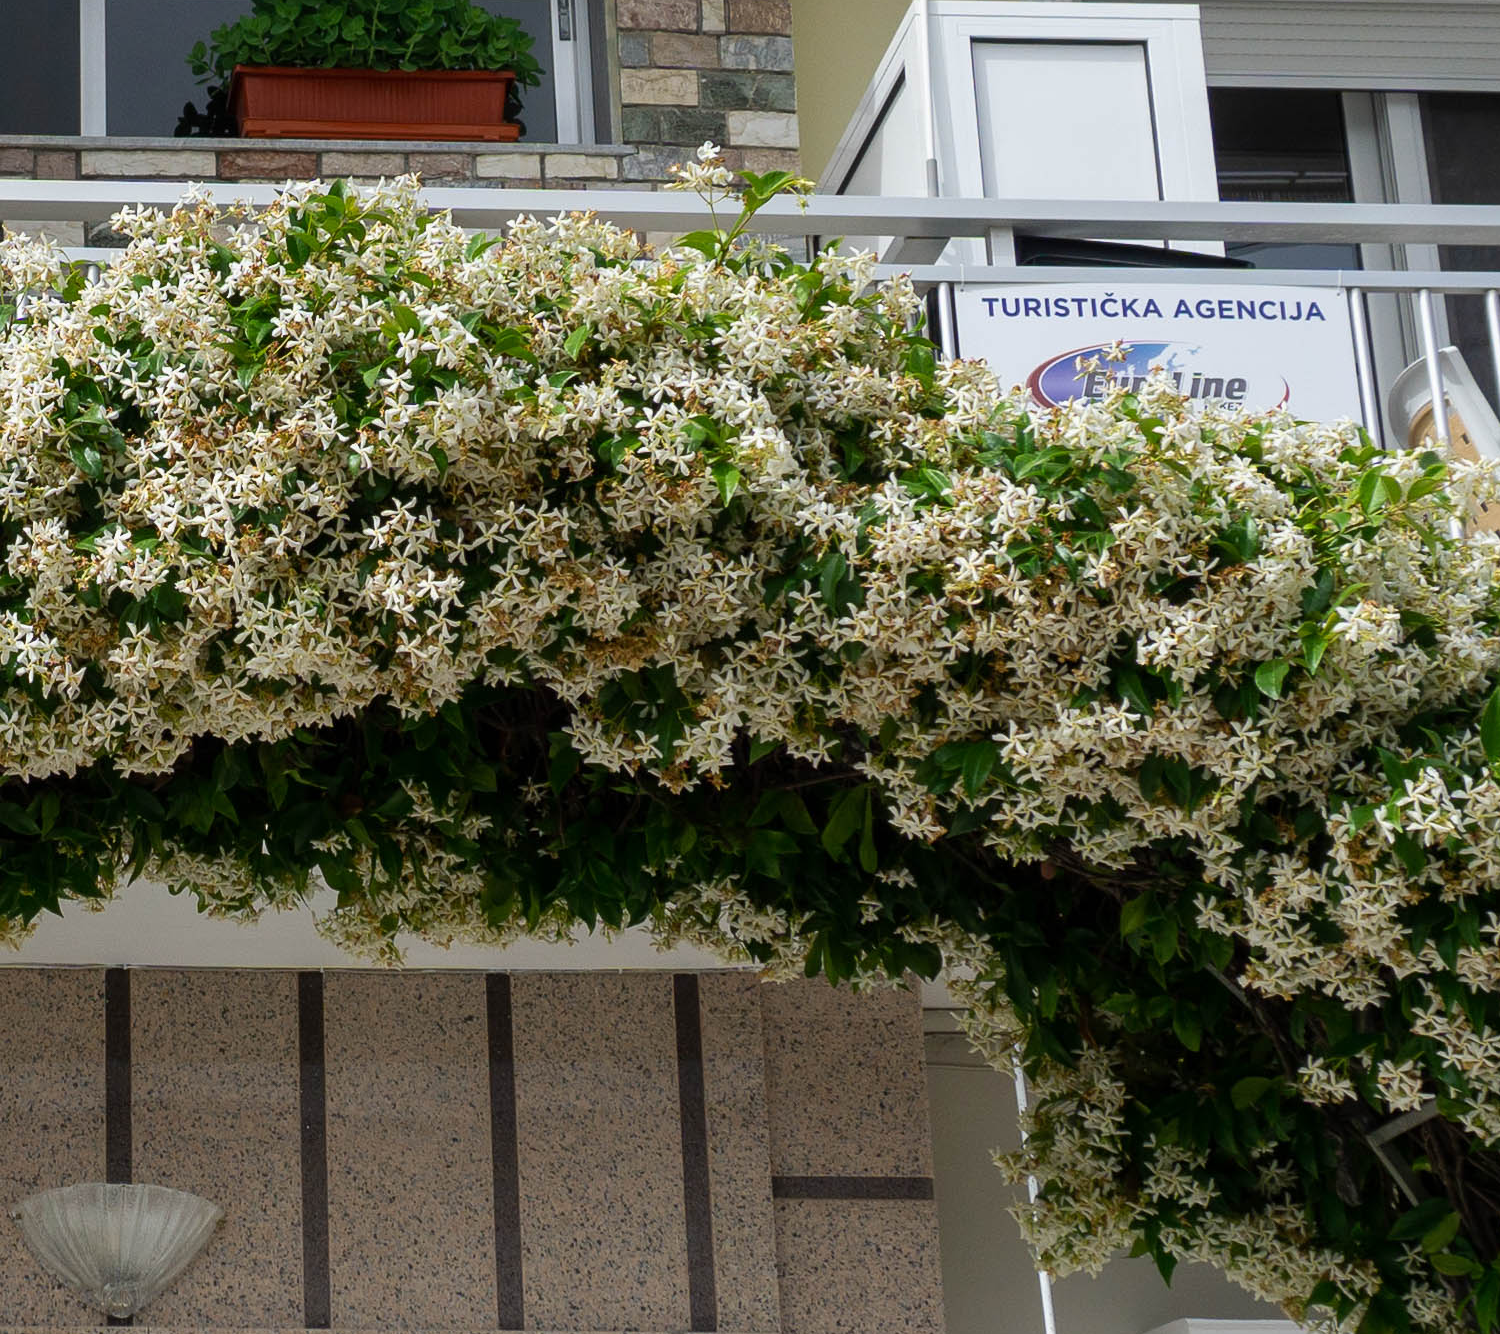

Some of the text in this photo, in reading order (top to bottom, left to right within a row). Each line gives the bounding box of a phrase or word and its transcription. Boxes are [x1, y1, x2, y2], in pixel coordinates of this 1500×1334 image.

[982, 292, 1326, 321] TURISTIČKA AGENCIJA
[1083, 371, 1247, 400] Erine
